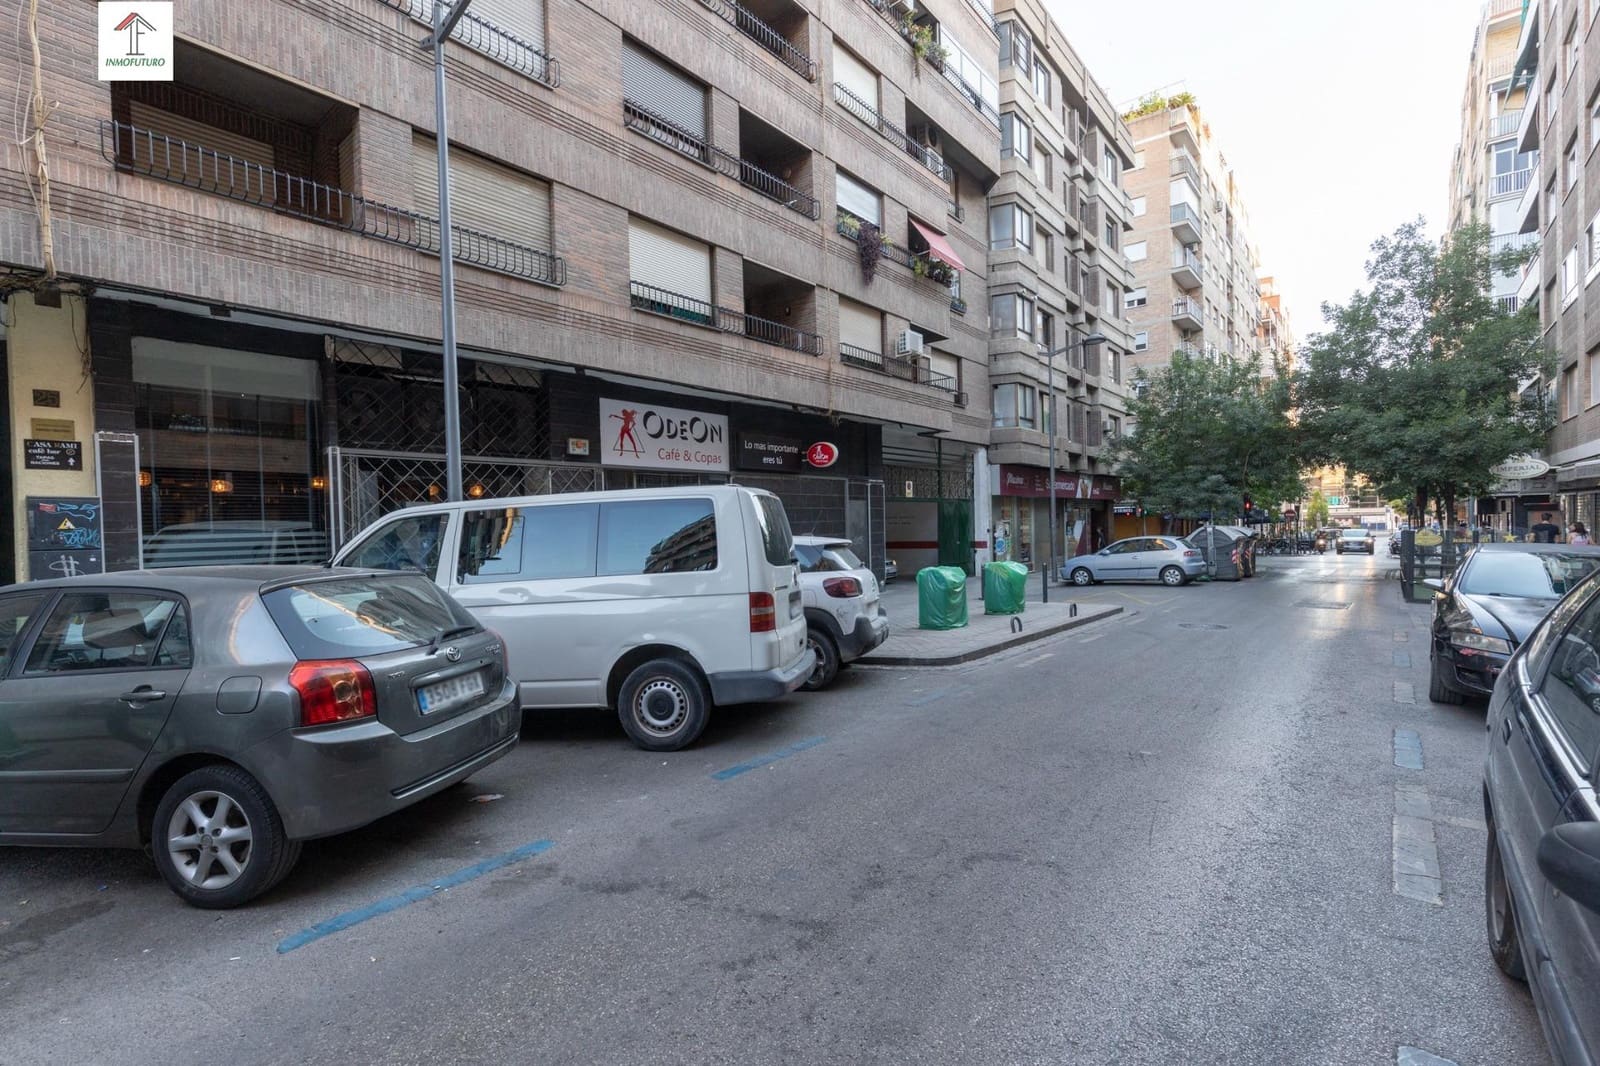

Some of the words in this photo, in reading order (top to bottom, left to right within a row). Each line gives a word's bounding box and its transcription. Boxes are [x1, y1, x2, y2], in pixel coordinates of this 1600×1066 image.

[744, 440, 753, 449] Lo
[767, 442, 799, 454] importante
[658, 448, 681, 461] Café
[684, 450, 691, 462] &
[694, 450, 723, 464] Copas
[762, 456, 775, 464] eres
[1496, 464, 1542, 473] IMPERIAL
